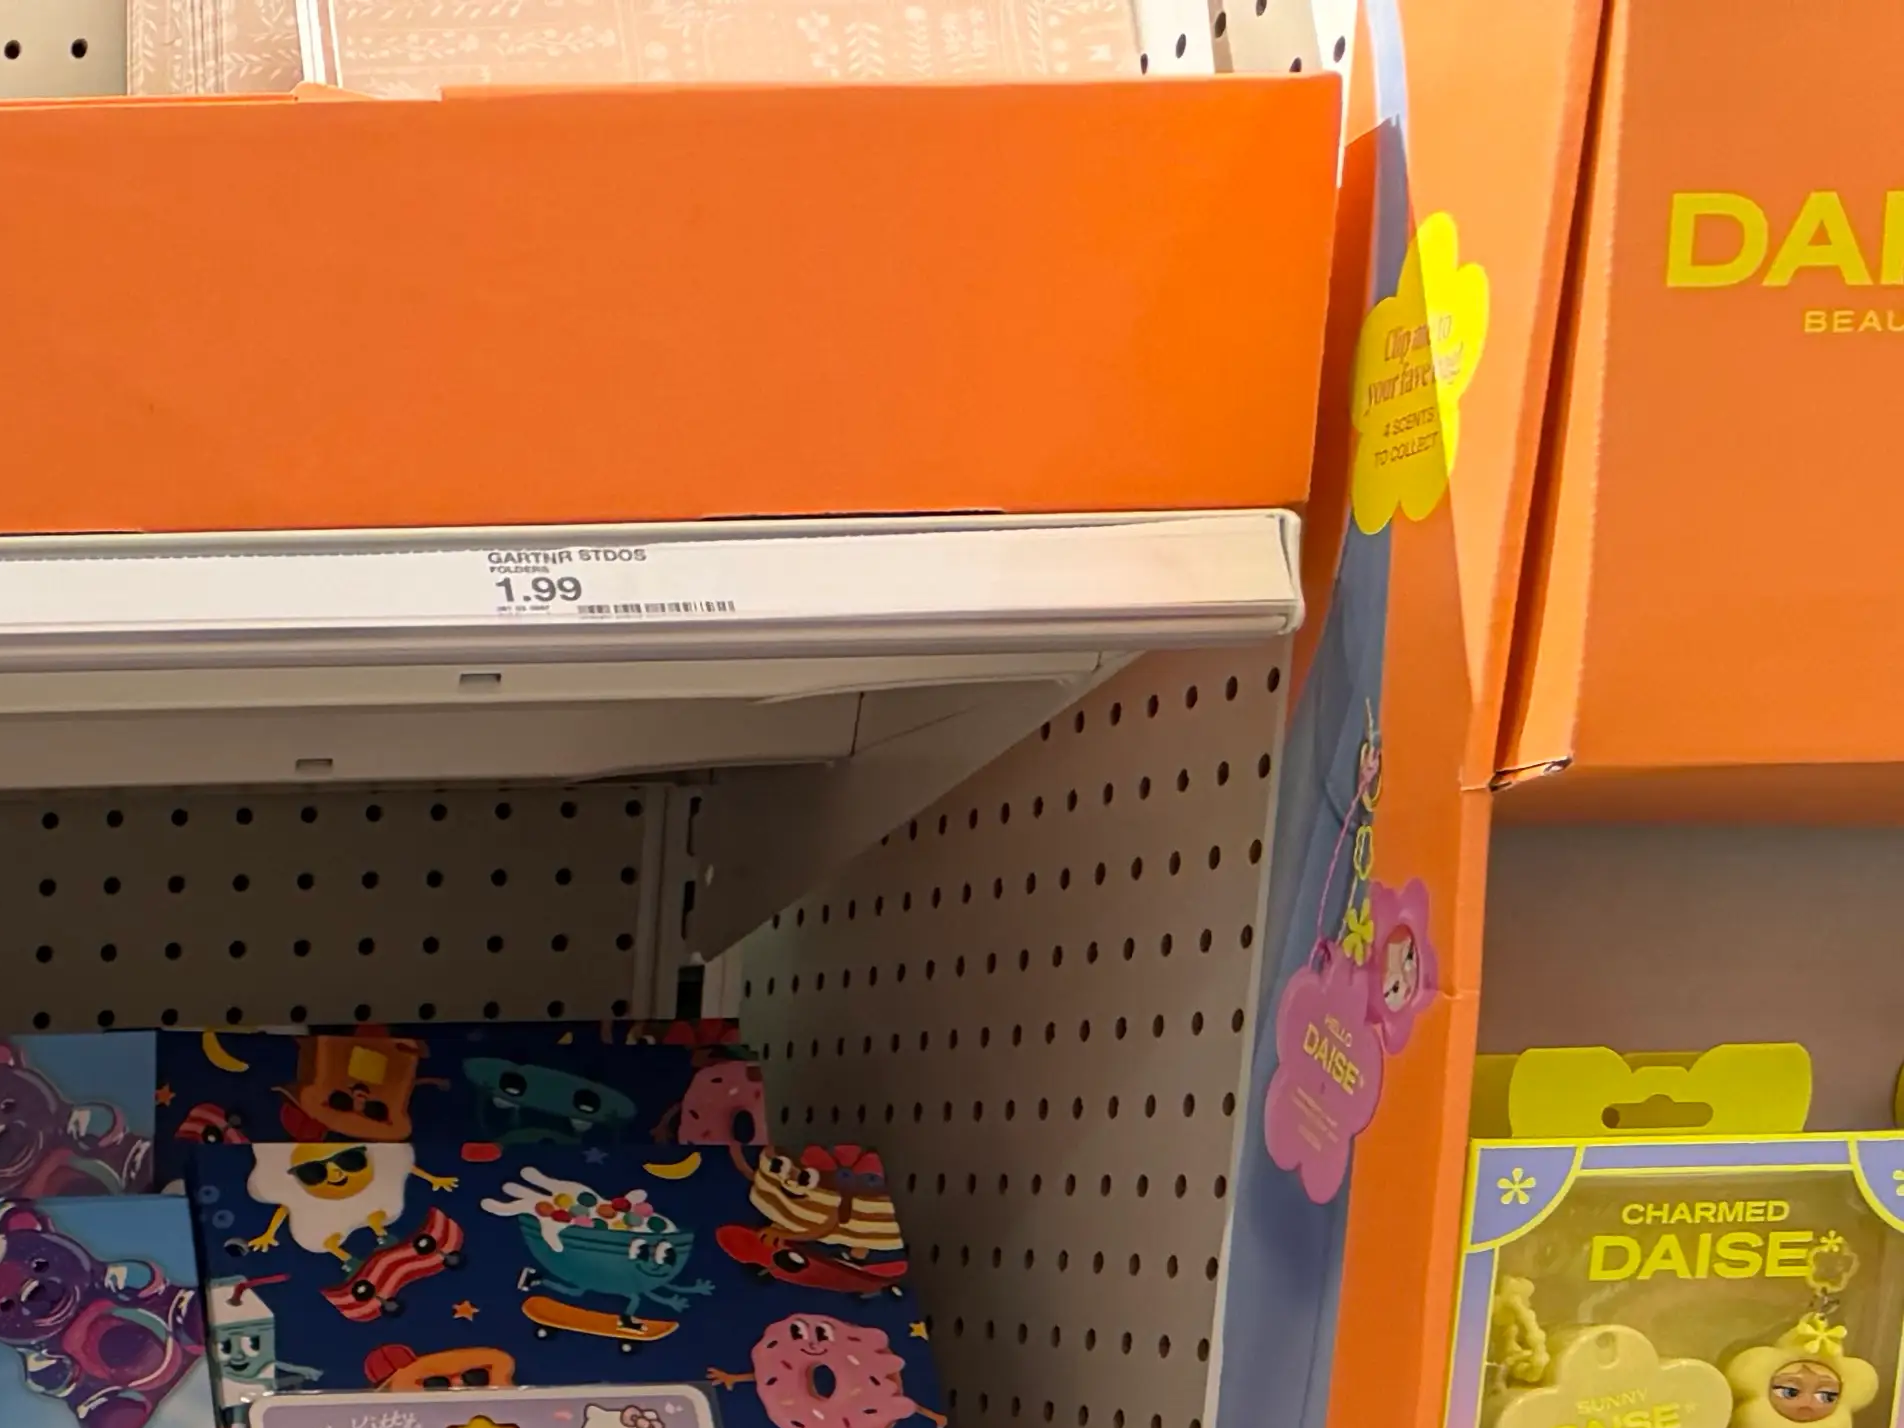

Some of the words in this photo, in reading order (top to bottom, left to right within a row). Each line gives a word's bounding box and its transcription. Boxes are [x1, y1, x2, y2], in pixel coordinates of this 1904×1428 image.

[487, 551, 573, 565] GARTNR
[578, 549, 647, 562] STDOS
[495, 576, 582, 602] 1.99
[1324, 1013, 1353, 1048] HELLO
[1622, 1201, 1790, 1226] CHARMED
[1589, 1231, 1814, 1281] DAISE
[1576, 1387, 1648, 1416] SUNNY
